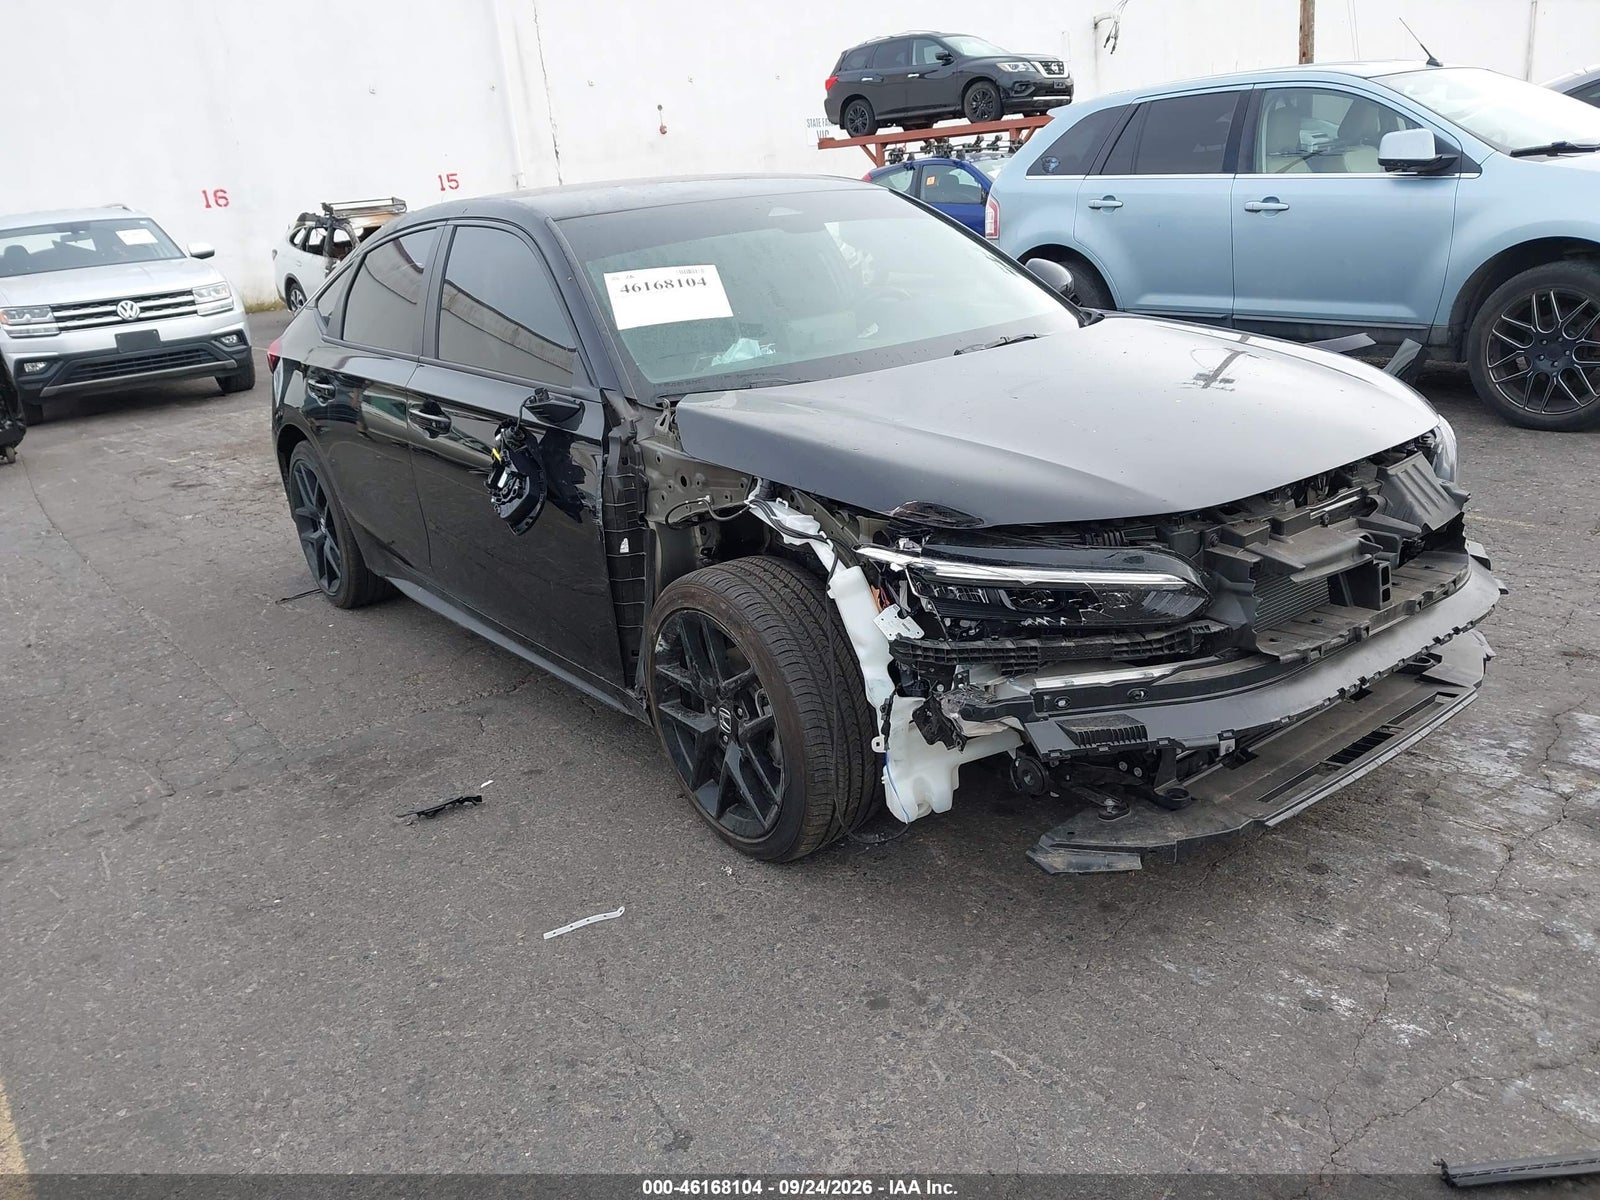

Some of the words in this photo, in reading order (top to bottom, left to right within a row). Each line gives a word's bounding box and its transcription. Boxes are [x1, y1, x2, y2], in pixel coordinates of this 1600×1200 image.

[437, 173, 460, 191] 15
[201, 188, 230, 208] 16
[619, 276, 707, 294] 46168104
